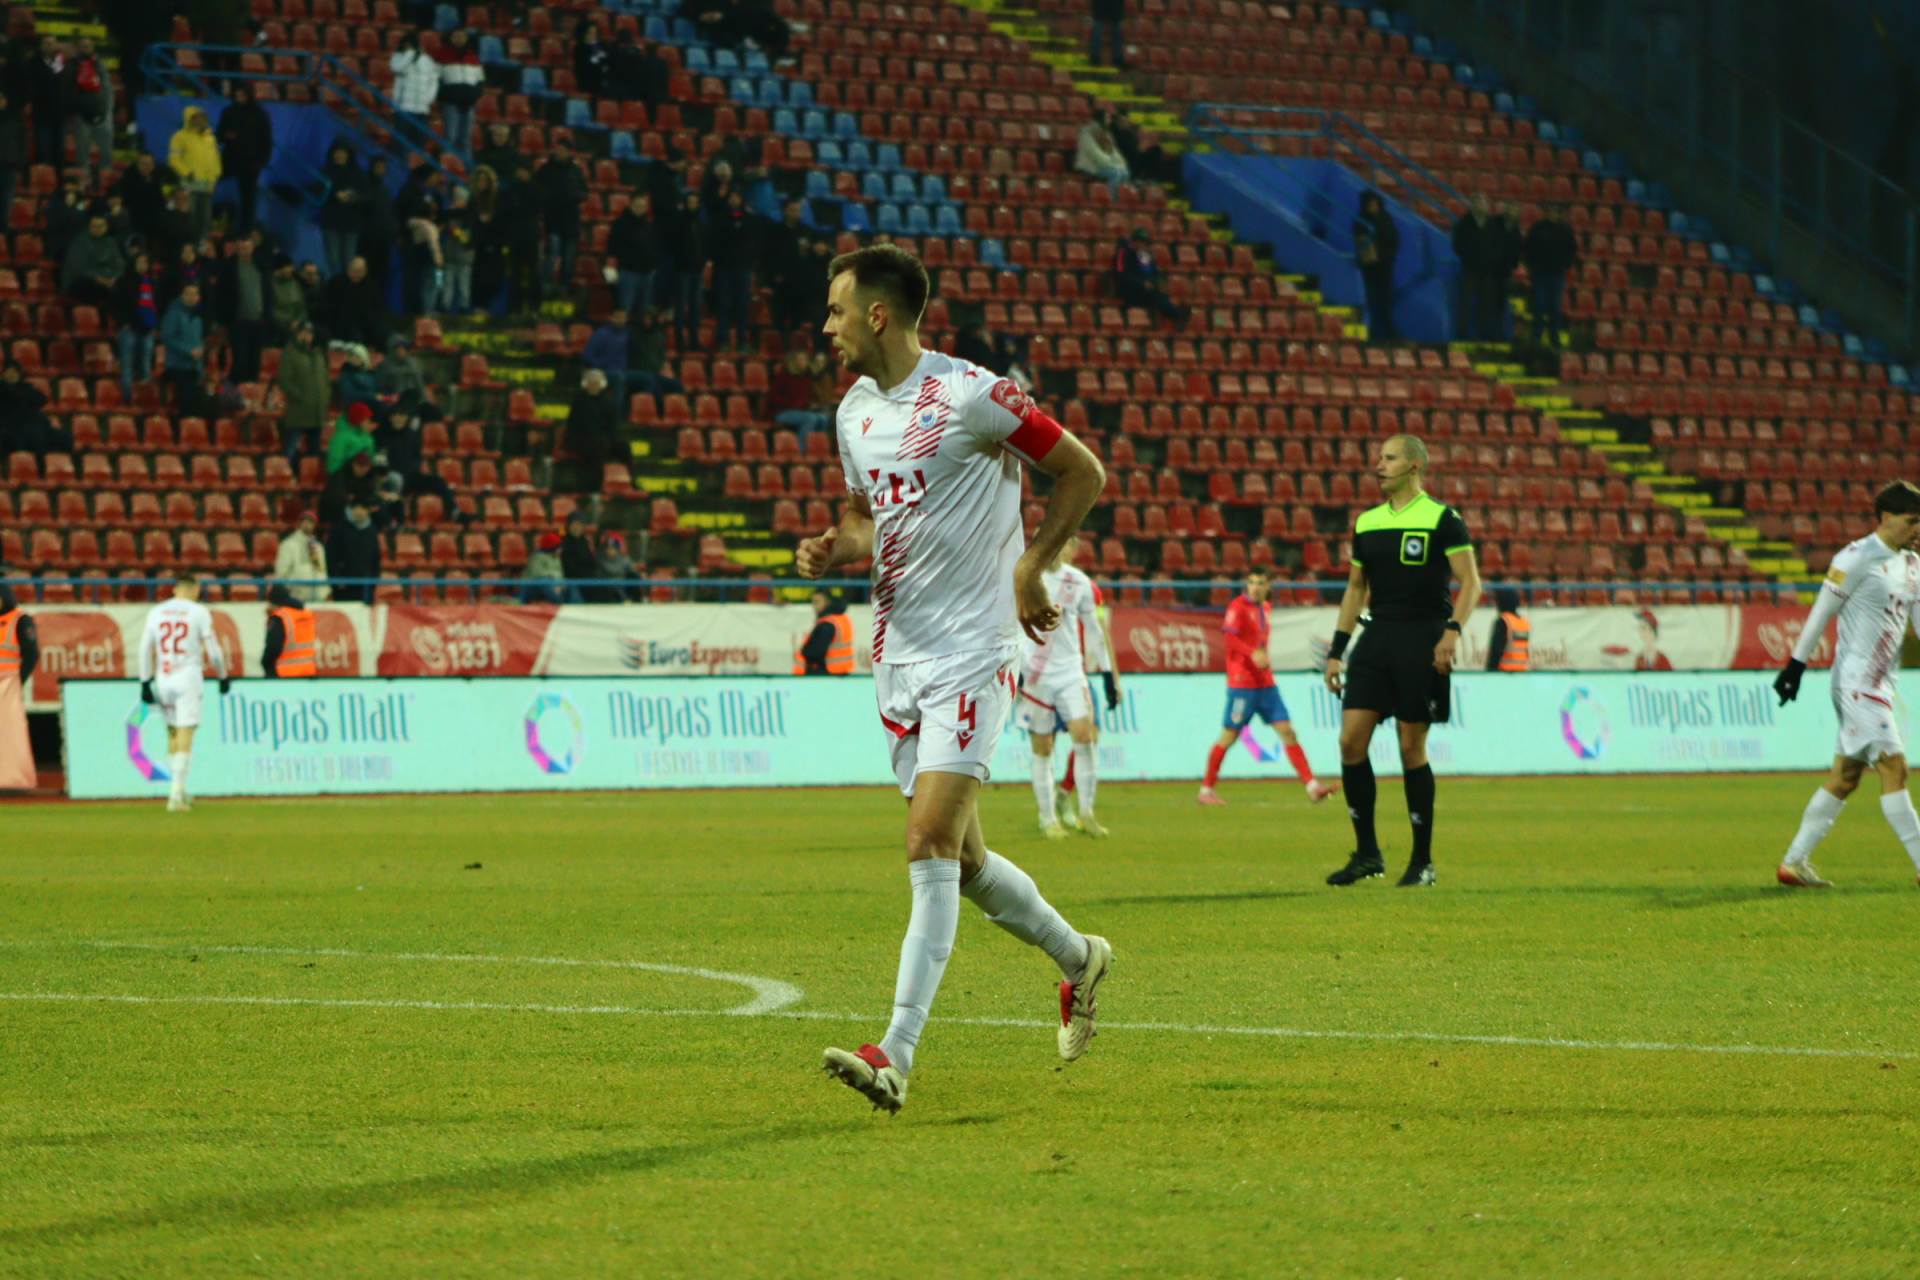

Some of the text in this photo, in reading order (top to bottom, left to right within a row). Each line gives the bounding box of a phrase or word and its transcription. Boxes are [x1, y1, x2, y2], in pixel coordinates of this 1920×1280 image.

[159, 621, 189, 654] 22
[314, 633, 350, 669] tel
[219, 693, 410, 751] Mepas Mall
[608, 690, 787, 745] Mepas Mall
[958, 691, 977, 730] 4
[1627, 684, 1775, 733] Mepas Mall
